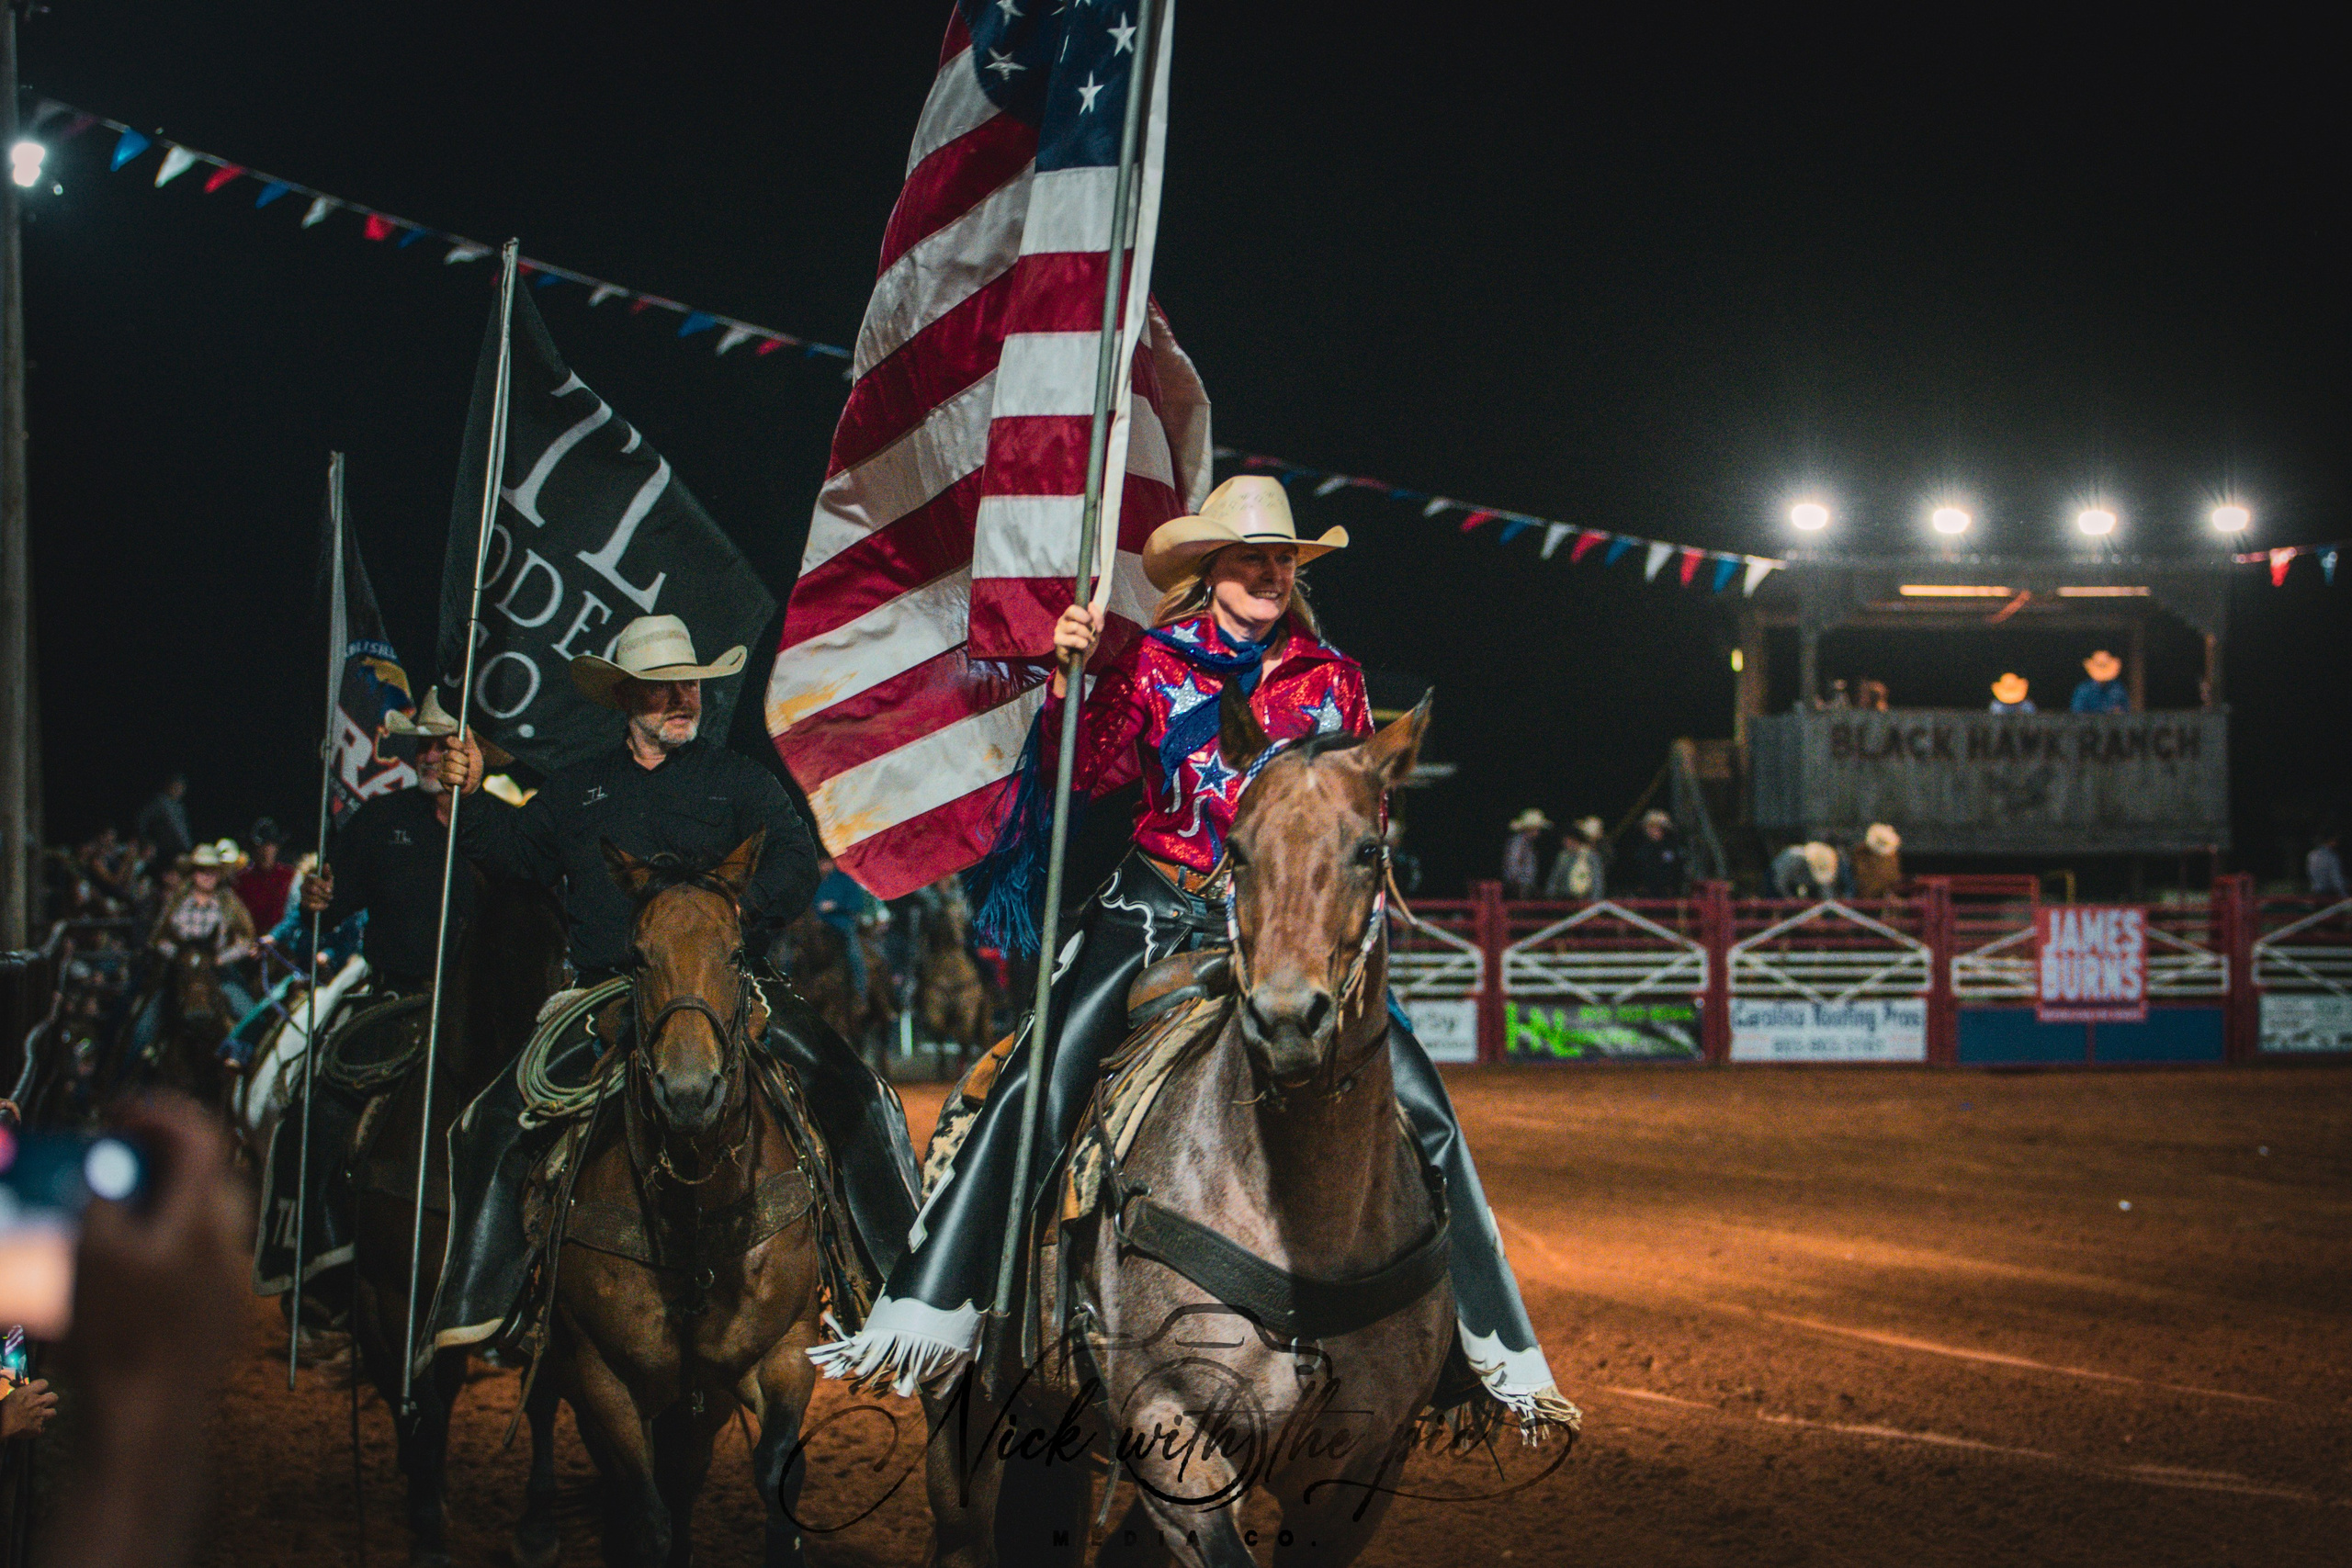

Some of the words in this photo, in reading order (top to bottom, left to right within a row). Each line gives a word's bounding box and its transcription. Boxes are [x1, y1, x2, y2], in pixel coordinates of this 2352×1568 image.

[1830, 724, 1955, 760] BLACK
[1967, 726, 2064, 761] HAWK
[2078, 726, 2201, 761] RANCH
[2042, 908, 2143, 953] JAMES
[2042, 956, 2142, 999] BURNS
